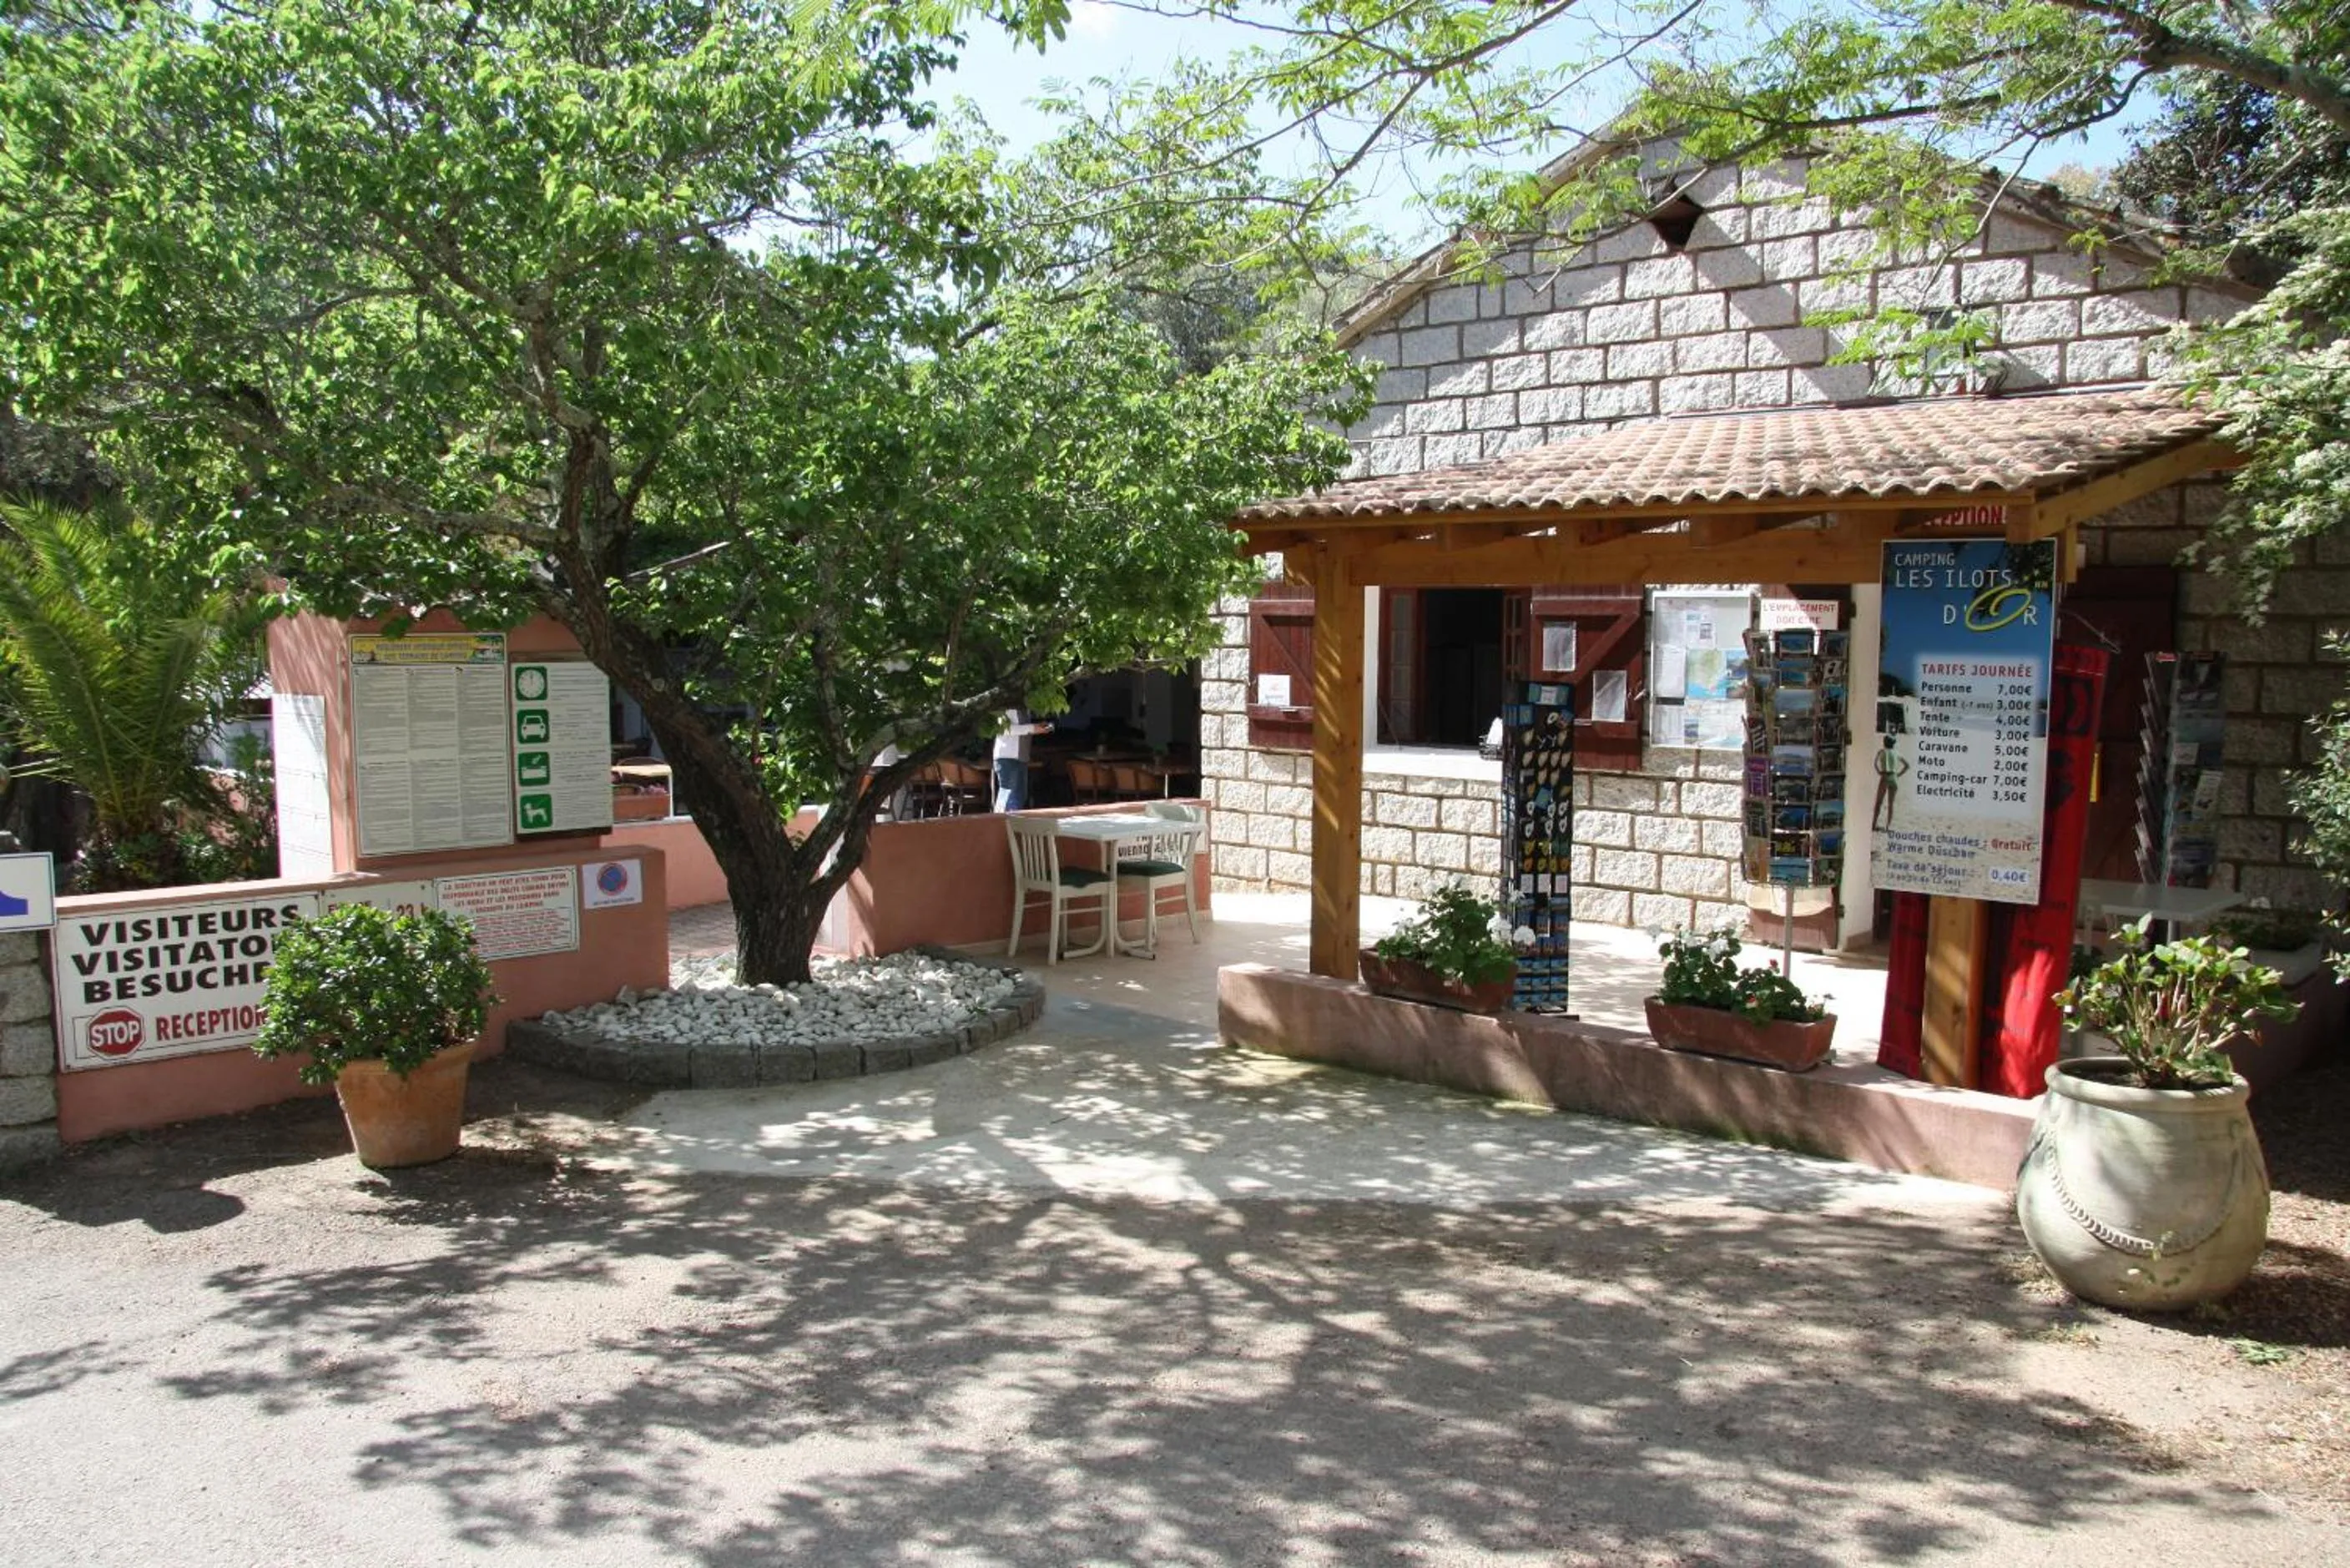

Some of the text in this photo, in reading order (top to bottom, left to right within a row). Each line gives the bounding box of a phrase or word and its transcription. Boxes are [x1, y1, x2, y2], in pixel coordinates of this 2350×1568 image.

[1894, 552, 1955, 566] CAMPING
[1895, 570, 2012, 588] LES ILOTS
[1921, 663, 2032, 678] TARIFS JOURNÉE
[1921, 681, 2032, 695] Personne 7,00€
[1919, 696, 1958, 708] Enfant
[1996, 699, 2032, 710] 3,00€
[1919, 711, 2030, 726] Tente 4,00€
[1919, 726, 2030, 741] Voiture 3,00€
[1919, 741, 2029, 756] Caravane 5,00€
[1918, 755, 2029, 772] Moto 2,00€
[1917, 770, 2028, 787] Camping-car 7,00€
[1916, 784, 2027, 802] Electricité 3,50€
[1888, 830, 1932, 843] Douches
[1935, 834, 1980, 847] chaudes
[1990, 838, 2032, 851] Gratuit
[1990, 870, 2027, 883] 0,40€
[80, 905, 299, 946] VISITEURS
[72, 934, 277, 976] VISITATO
[83, 961, 274, 1003] BESUCHE
[91, 1020, 140, 1046] STOP
